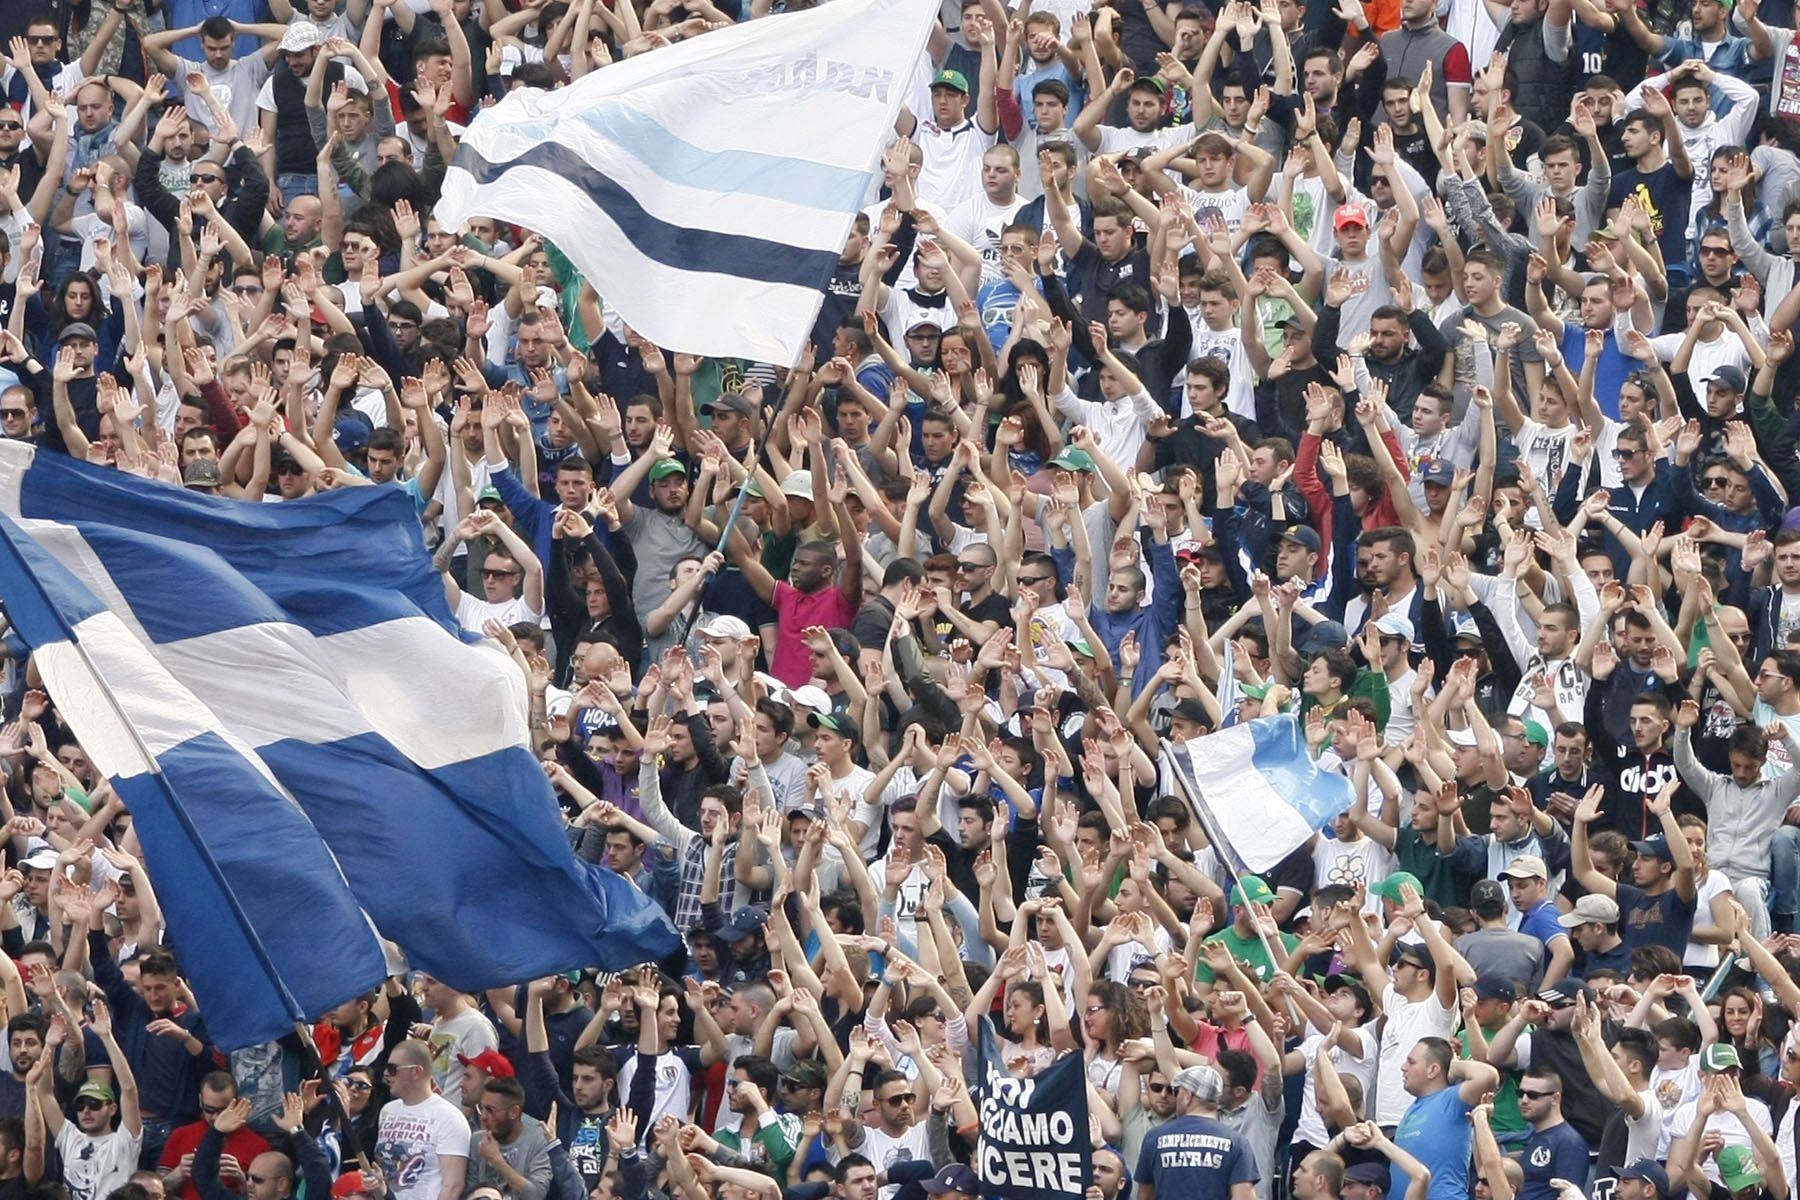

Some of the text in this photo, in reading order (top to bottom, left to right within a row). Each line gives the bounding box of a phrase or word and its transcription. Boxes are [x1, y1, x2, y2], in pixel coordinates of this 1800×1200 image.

[1582, 51, 1603, 74] 10
[1156, 1134, 1231, 1153] SEMPLICEMENTE
[1159, 1149, 1222, 1169] ULTRAS
